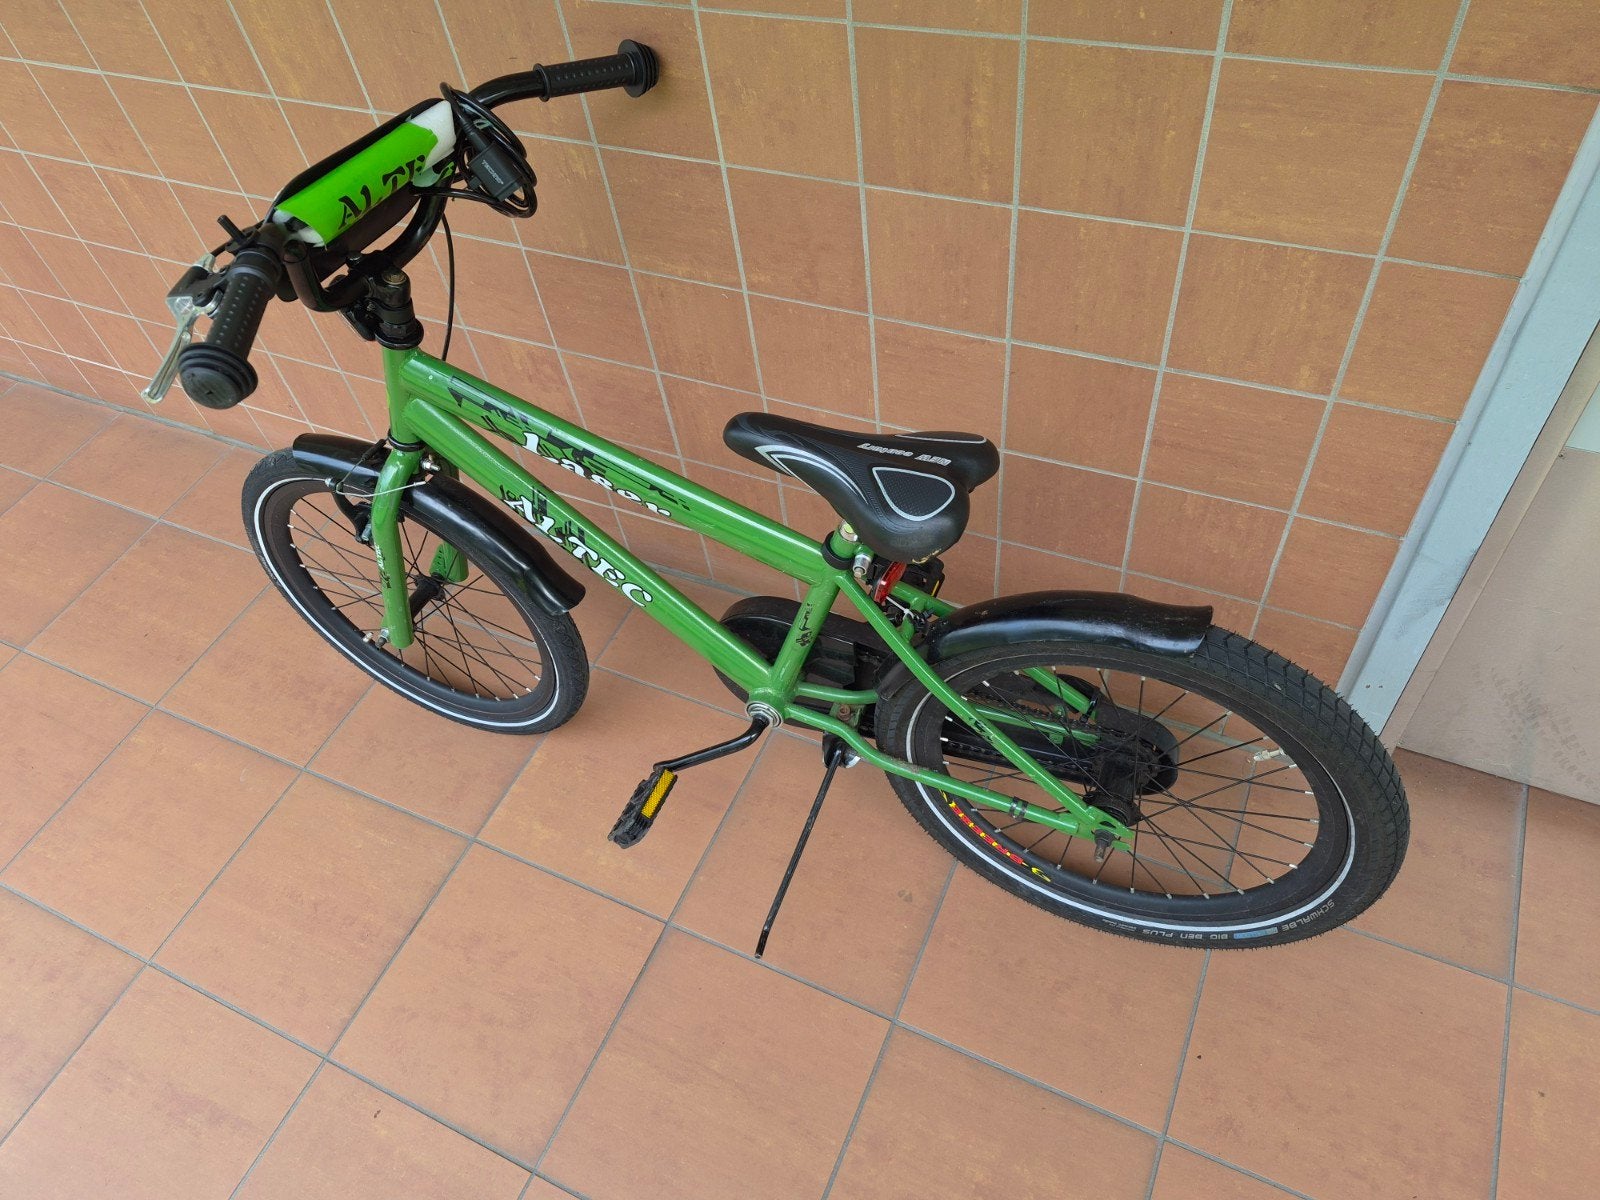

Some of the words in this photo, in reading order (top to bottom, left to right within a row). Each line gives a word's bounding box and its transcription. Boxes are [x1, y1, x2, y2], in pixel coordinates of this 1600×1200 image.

[502, 493, 653, 607] ALTEC
[1281, 899, 1335, 932] SCHWALBE
[1142, 928, 1174, 939] PLUS
